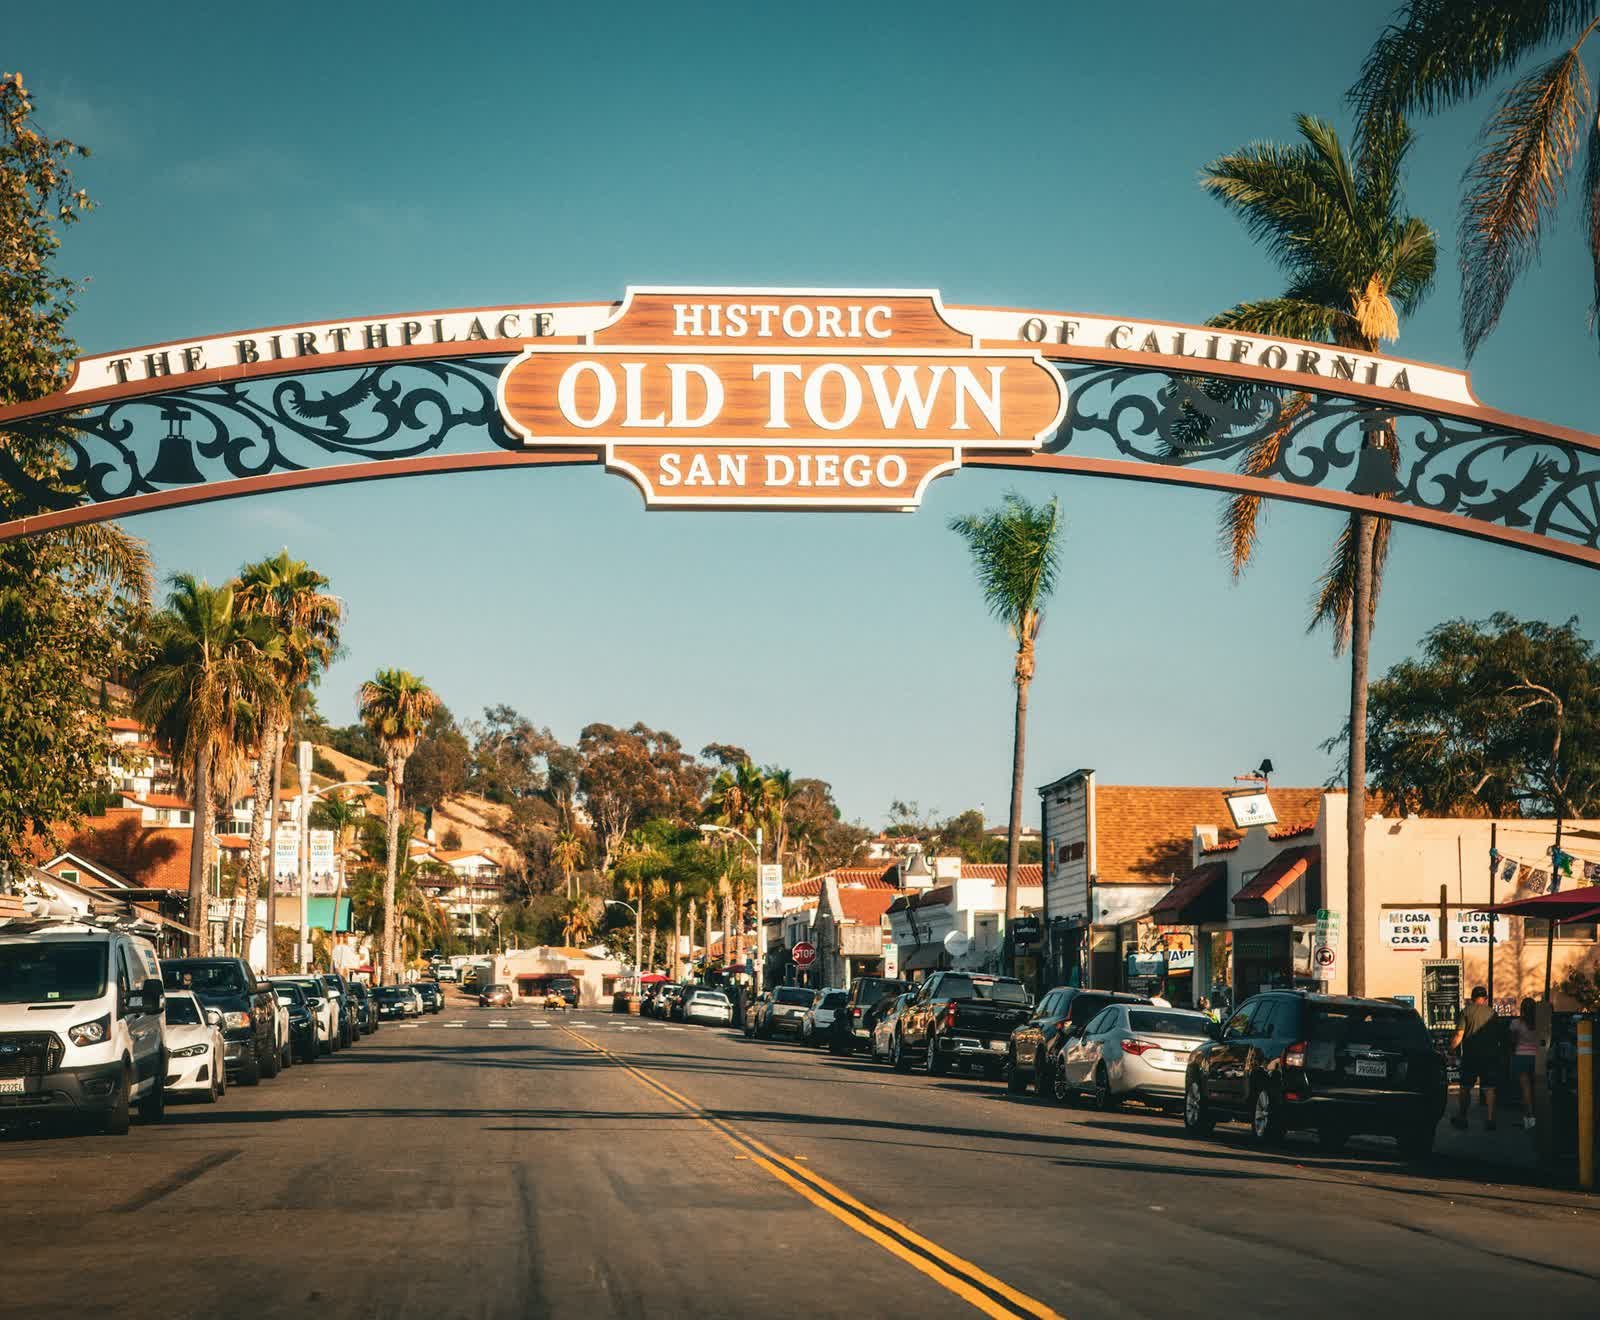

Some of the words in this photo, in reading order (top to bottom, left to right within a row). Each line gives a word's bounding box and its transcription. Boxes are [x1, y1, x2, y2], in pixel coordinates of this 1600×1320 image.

[672, 303, 893, 339] HISTORIC
[106, 345, 209, 385] THE
[236, 311, 558, 364] BIRTHPLACE
[1021, 316, 1081, 345] OF
[1109, 324, 1412, 393] CALIFORNIA
[556, 360, 725, 430] OLD
[751, 362, 1007, 437] TOWN
[657, 452, 748, 487] SAN
[763, 453, 909, 489] DIEGO
[1405, 913, 1431, 922] CASA
[1462, 925, 1478, 933] ES
[794, 949, 815, 960] STOP
[1391, 936, 1430, 944] CASA
